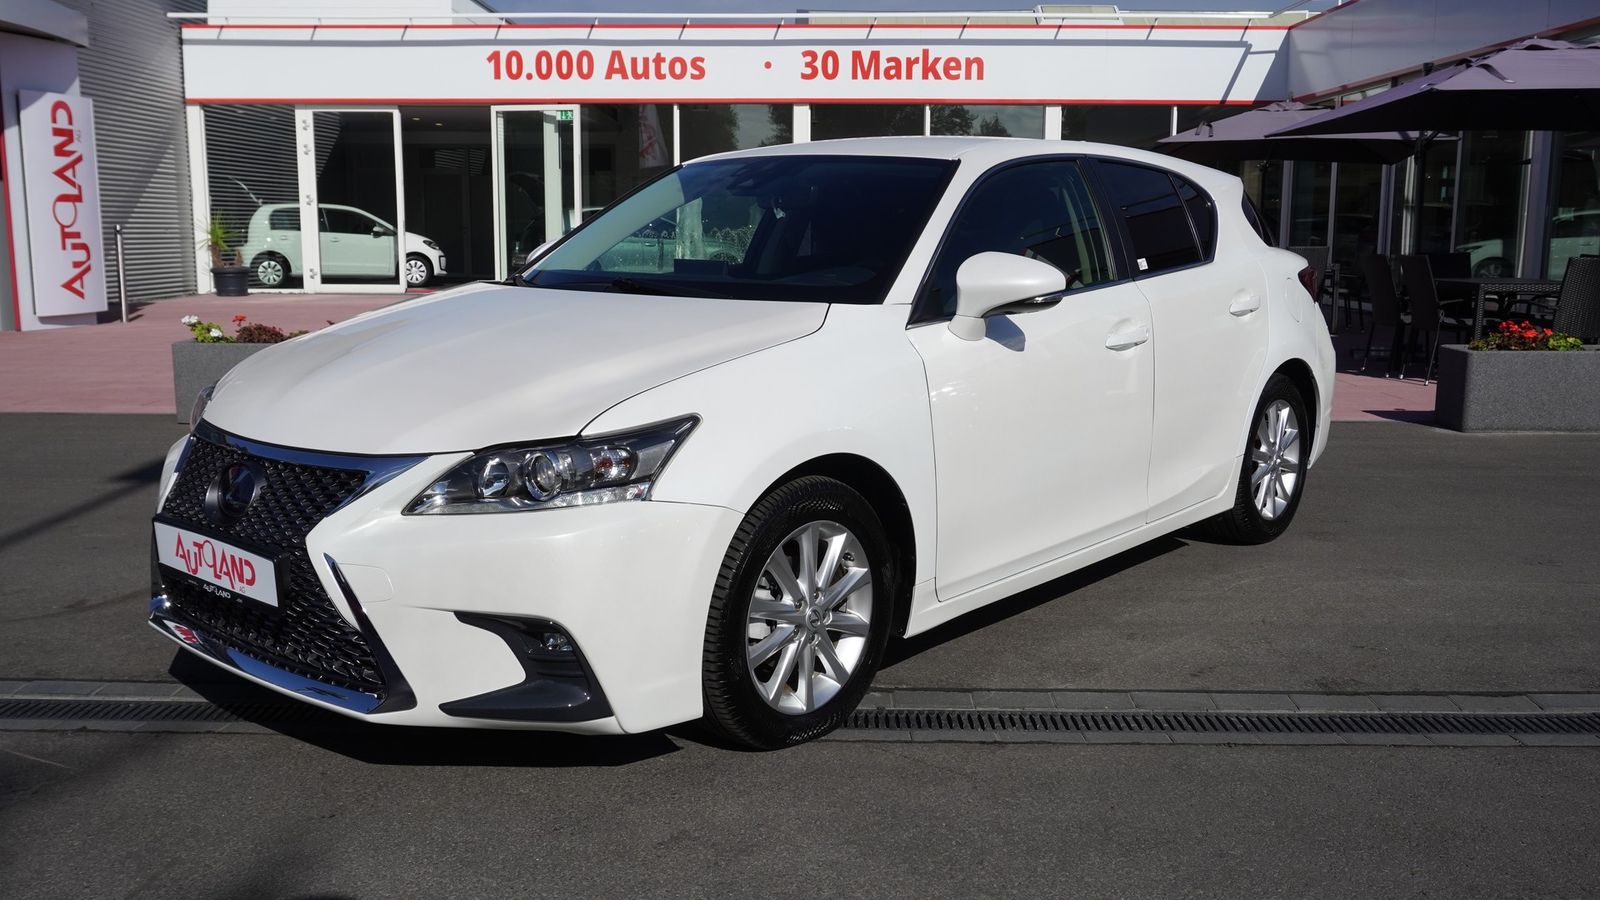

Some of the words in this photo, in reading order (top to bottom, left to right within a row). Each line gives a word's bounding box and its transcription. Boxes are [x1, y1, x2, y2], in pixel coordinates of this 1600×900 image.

[487, 49, 594, 80] 10.000
[605, 50, 705, 80] Autos
[801, 50, 840, 80] 30
[851, 48, 984, 80] Marken
[51, 100, 91, 299] AUTOLAND
[176, 532, 256, 590] AUTOLAND
